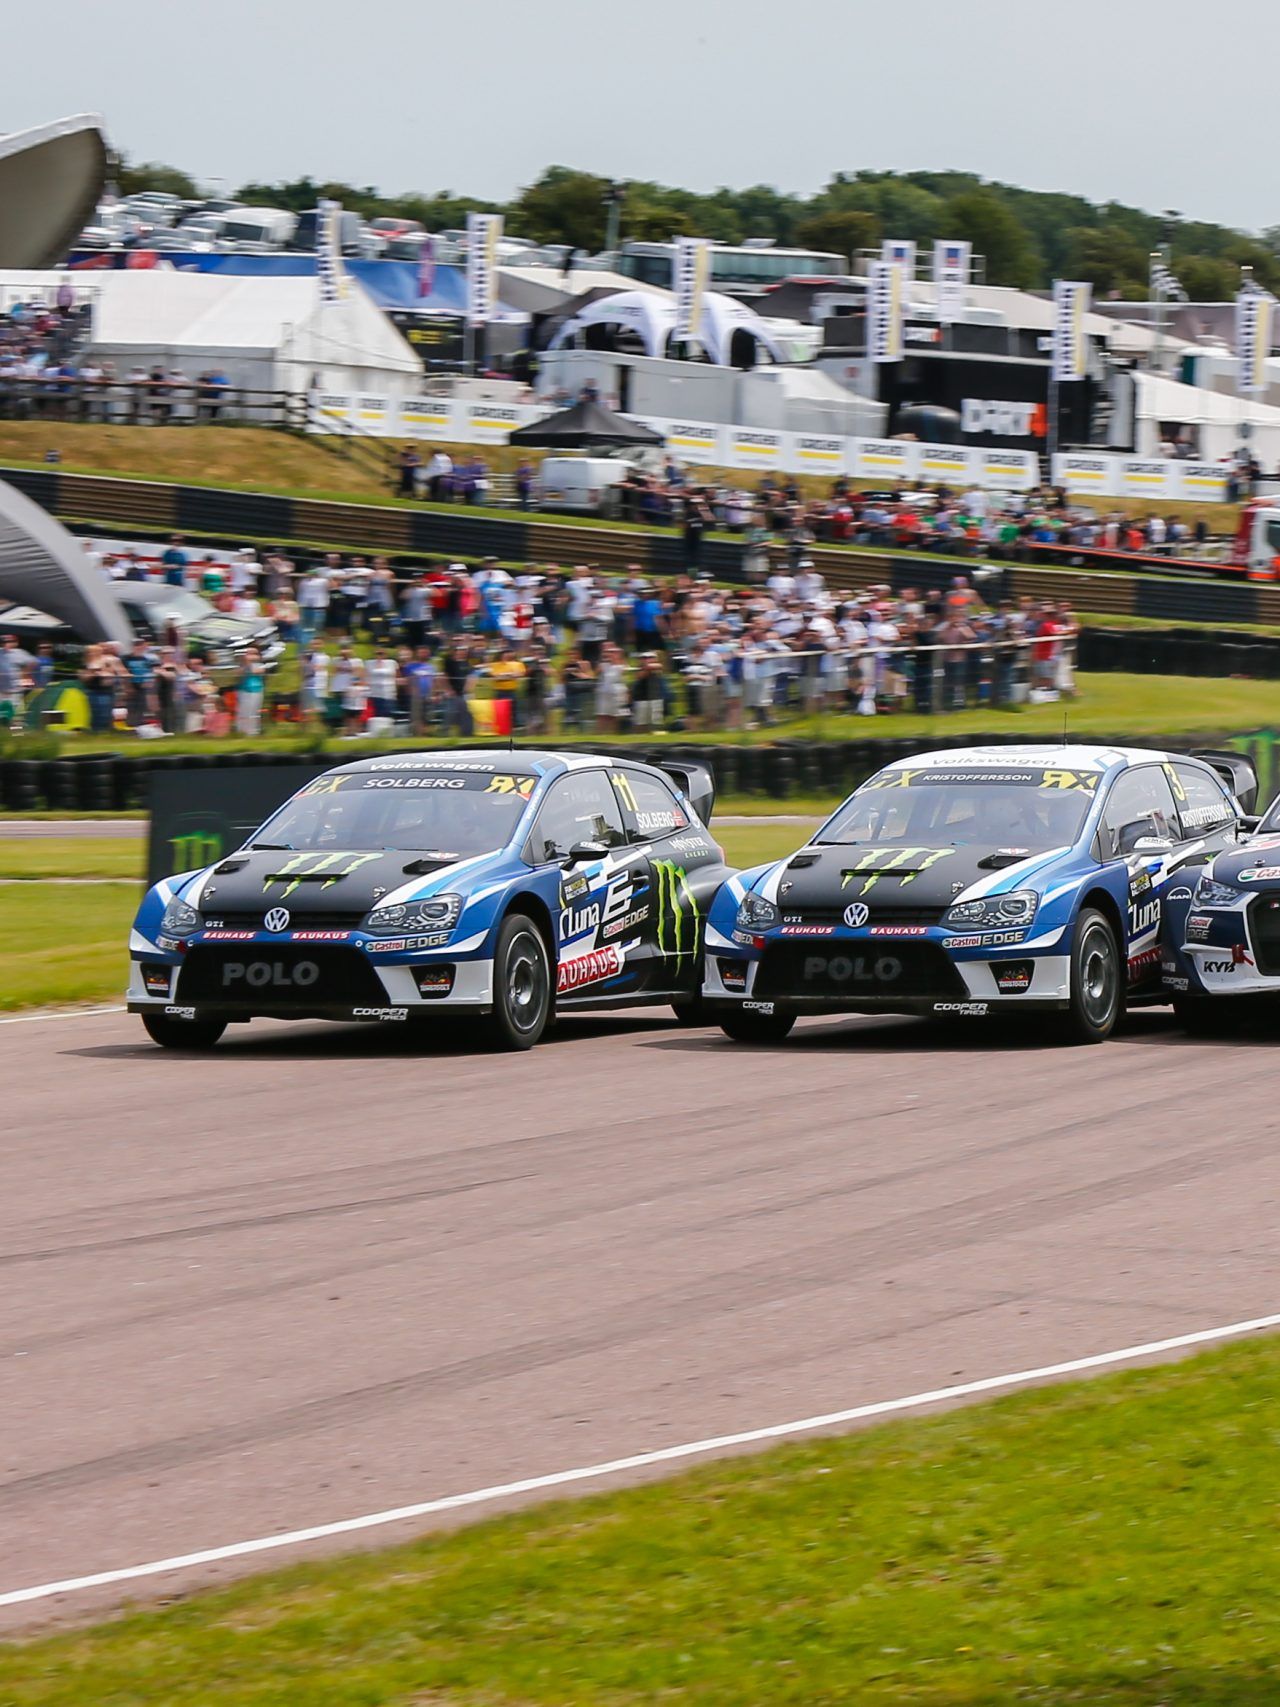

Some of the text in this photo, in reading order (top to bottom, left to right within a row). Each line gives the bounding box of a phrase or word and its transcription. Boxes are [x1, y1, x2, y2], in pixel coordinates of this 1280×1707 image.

[370, 762, 495, 771] Volkswagen
[933, 759, 1057, 767] Volkswagen
[363, 779, 466, 788] SOLBERG
[1163, 763, 1186, 801] 3
[612, 773, 638, 811] 11
[636, 811, 674, 829] SOLBERG
[624, 905, 649, 929] EDGE
[374, 934, 449, 951] Castrol EDGE
[951, 932, 1024, 947] Castrol EDGE
[222, 961, 320, 986] POLO
[559, 947, 618, 988] AUHAUS
[804, 957, 901, 981] POLO
[1204, 961, 1236, 973] KYB
[353, 1008, 408, 1016] COOPER
[934, 1003, 988, 1011] COOPER
